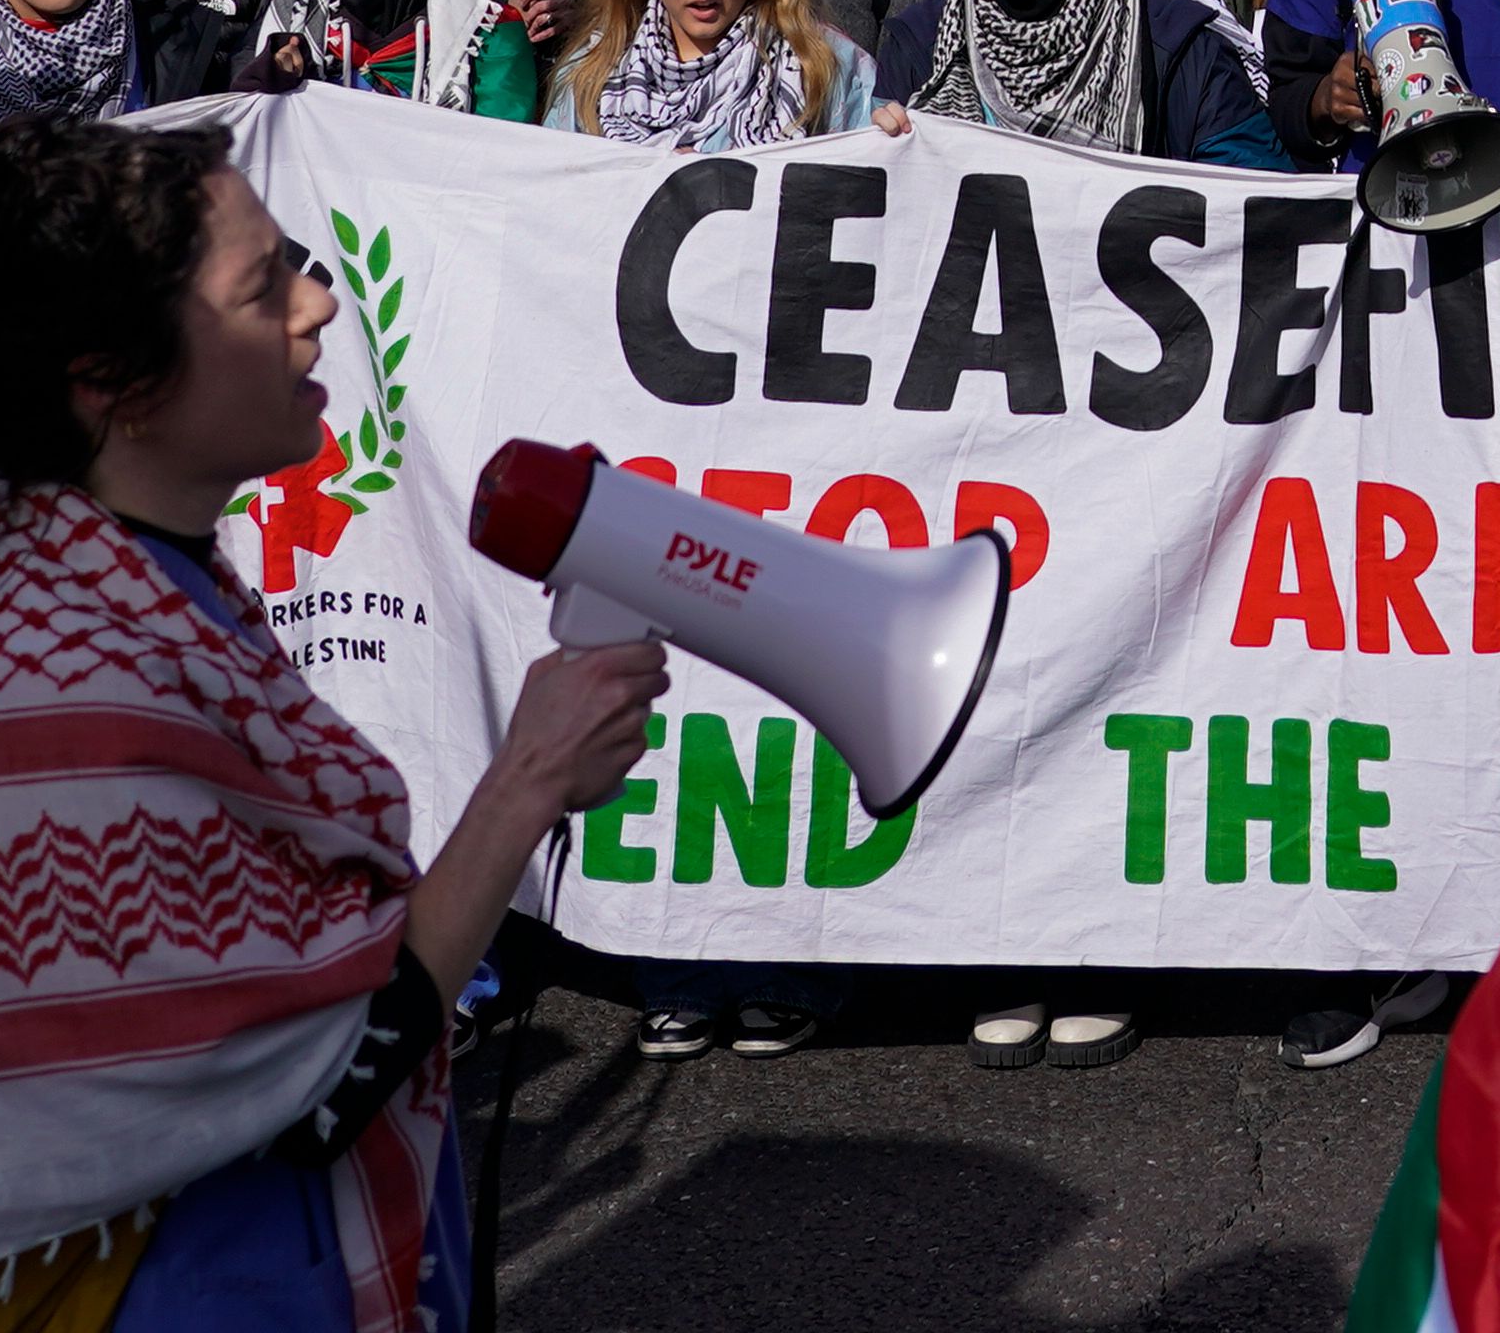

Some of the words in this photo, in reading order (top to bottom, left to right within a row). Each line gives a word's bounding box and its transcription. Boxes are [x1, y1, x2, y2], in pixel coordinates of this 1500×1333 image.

[363, 590, 405, 620] FOR
[415, 602, 428, 626] A
[581, 712, 920, 890] END
[1103, 712, 1398, 894] THE
